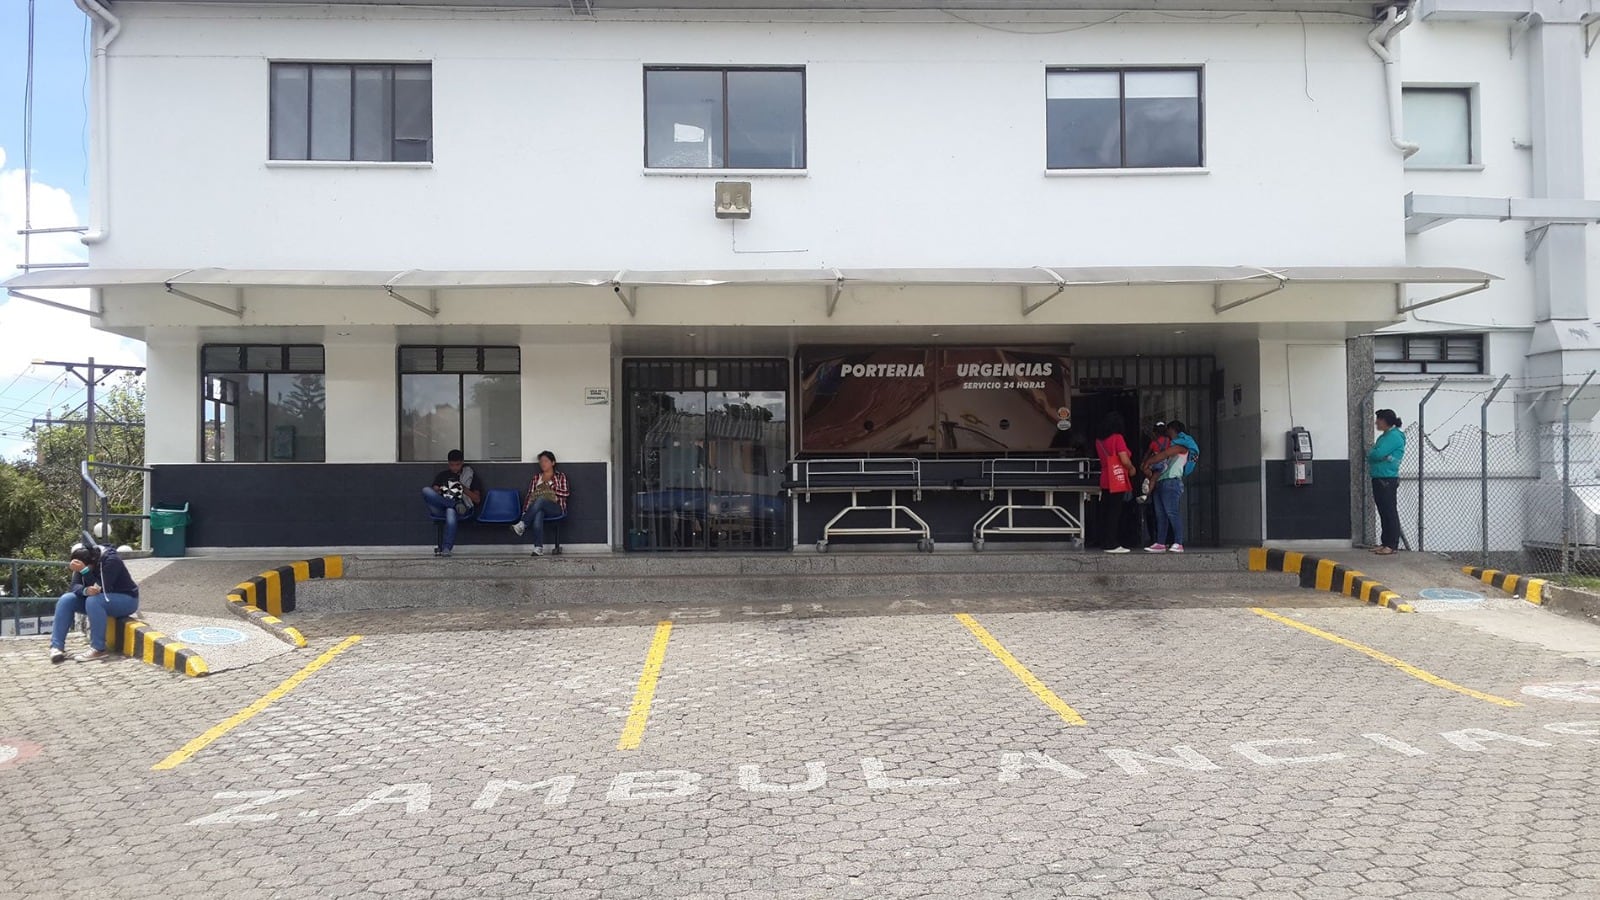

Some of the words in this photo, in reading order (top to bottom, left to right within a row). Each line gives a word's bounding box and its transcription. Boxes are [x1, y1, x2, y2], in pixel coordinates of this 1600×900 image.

[840, 363, 925, 378] PORTERIA
[956, 362, 1053, 378] URGENCIAS
[962, 381, 1001, 390] SERVICIO
[1003, 381, 1015, 390] 24
[1016, 381, 1046, 389] HORAS
